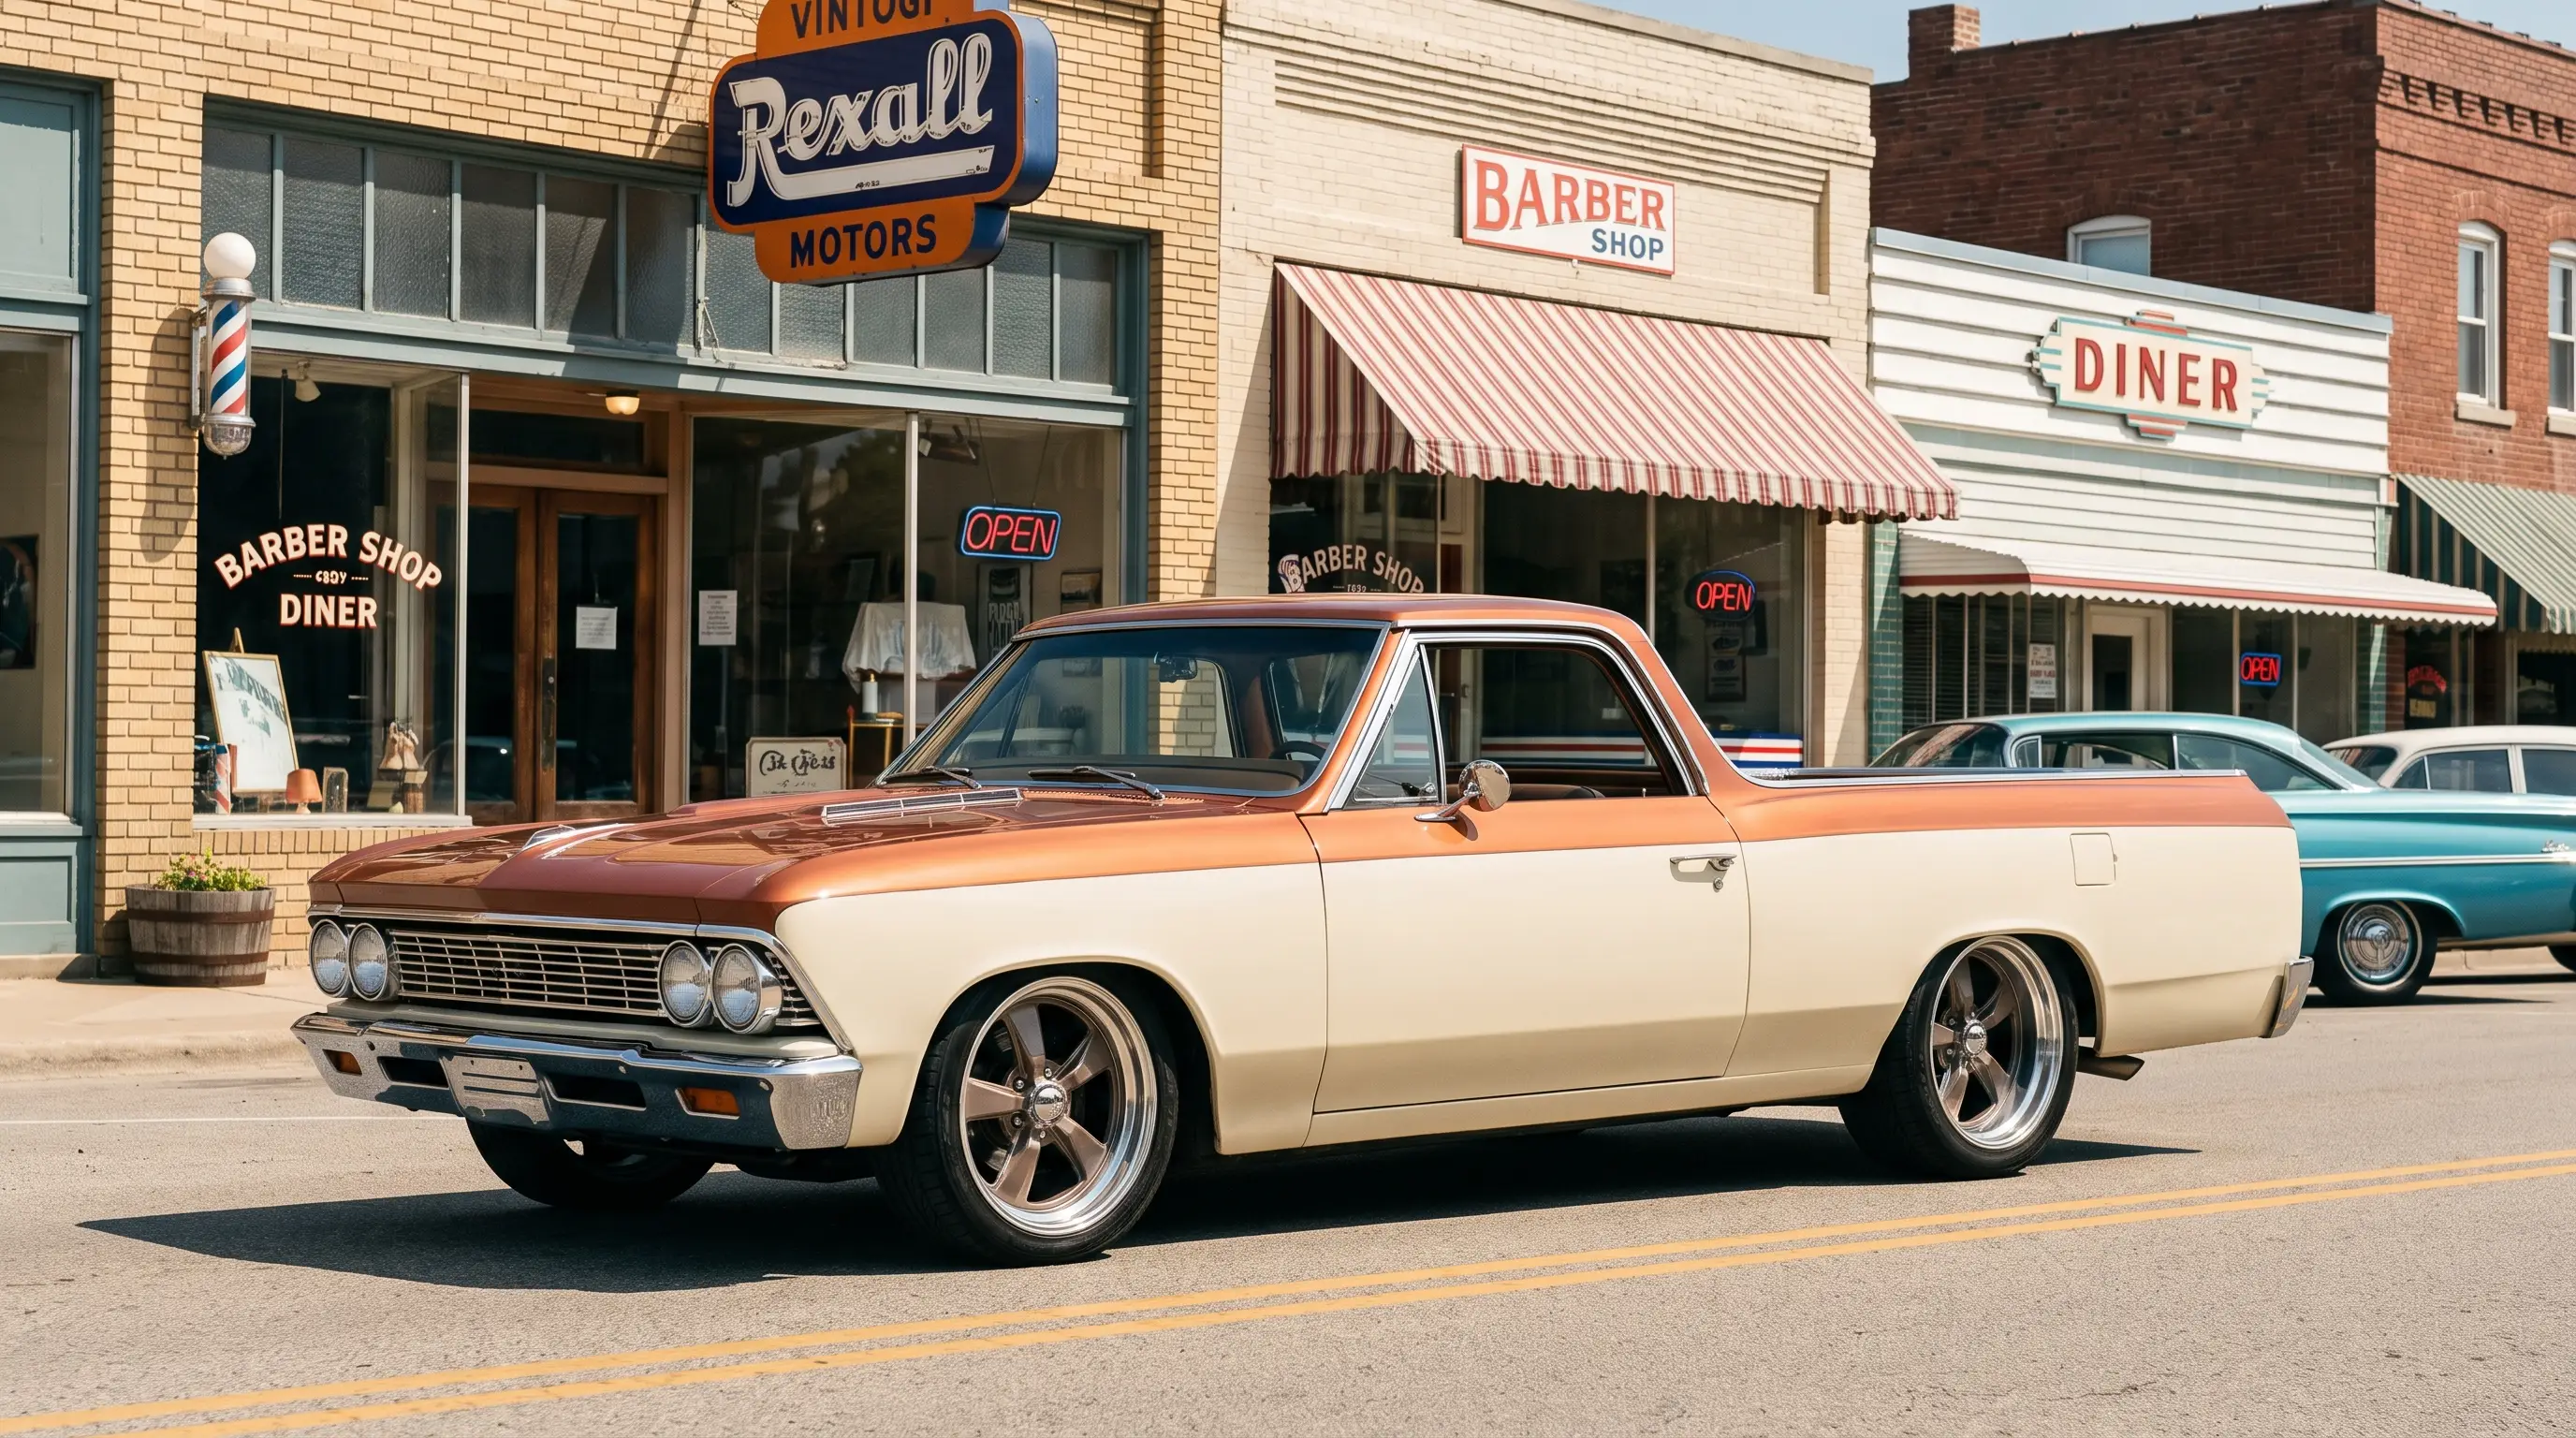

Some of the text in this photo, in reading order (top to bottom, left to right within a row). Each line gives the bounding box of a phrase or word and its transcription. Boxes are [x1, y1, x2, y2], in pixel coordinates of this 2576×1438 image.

[726, 33, 994, 207] Rexall
[1472, 159, 1666, 231] BARBER
[790, 214, 936, 268] MOTORS
[1591, 227, 1663, 260] SHOP
[2075, 337, 2238, 412] DINER
[966, 513, 1056, 554] OPEN
[214, 523, 443, 592] BARBER SHOP
[1372, 550, 1425, 594] SHOP
[280, 594, 377, 628] DINER
[1696, 581, 1752, 611] OPEN
[2241, 656, 2279, 682] OPEN
